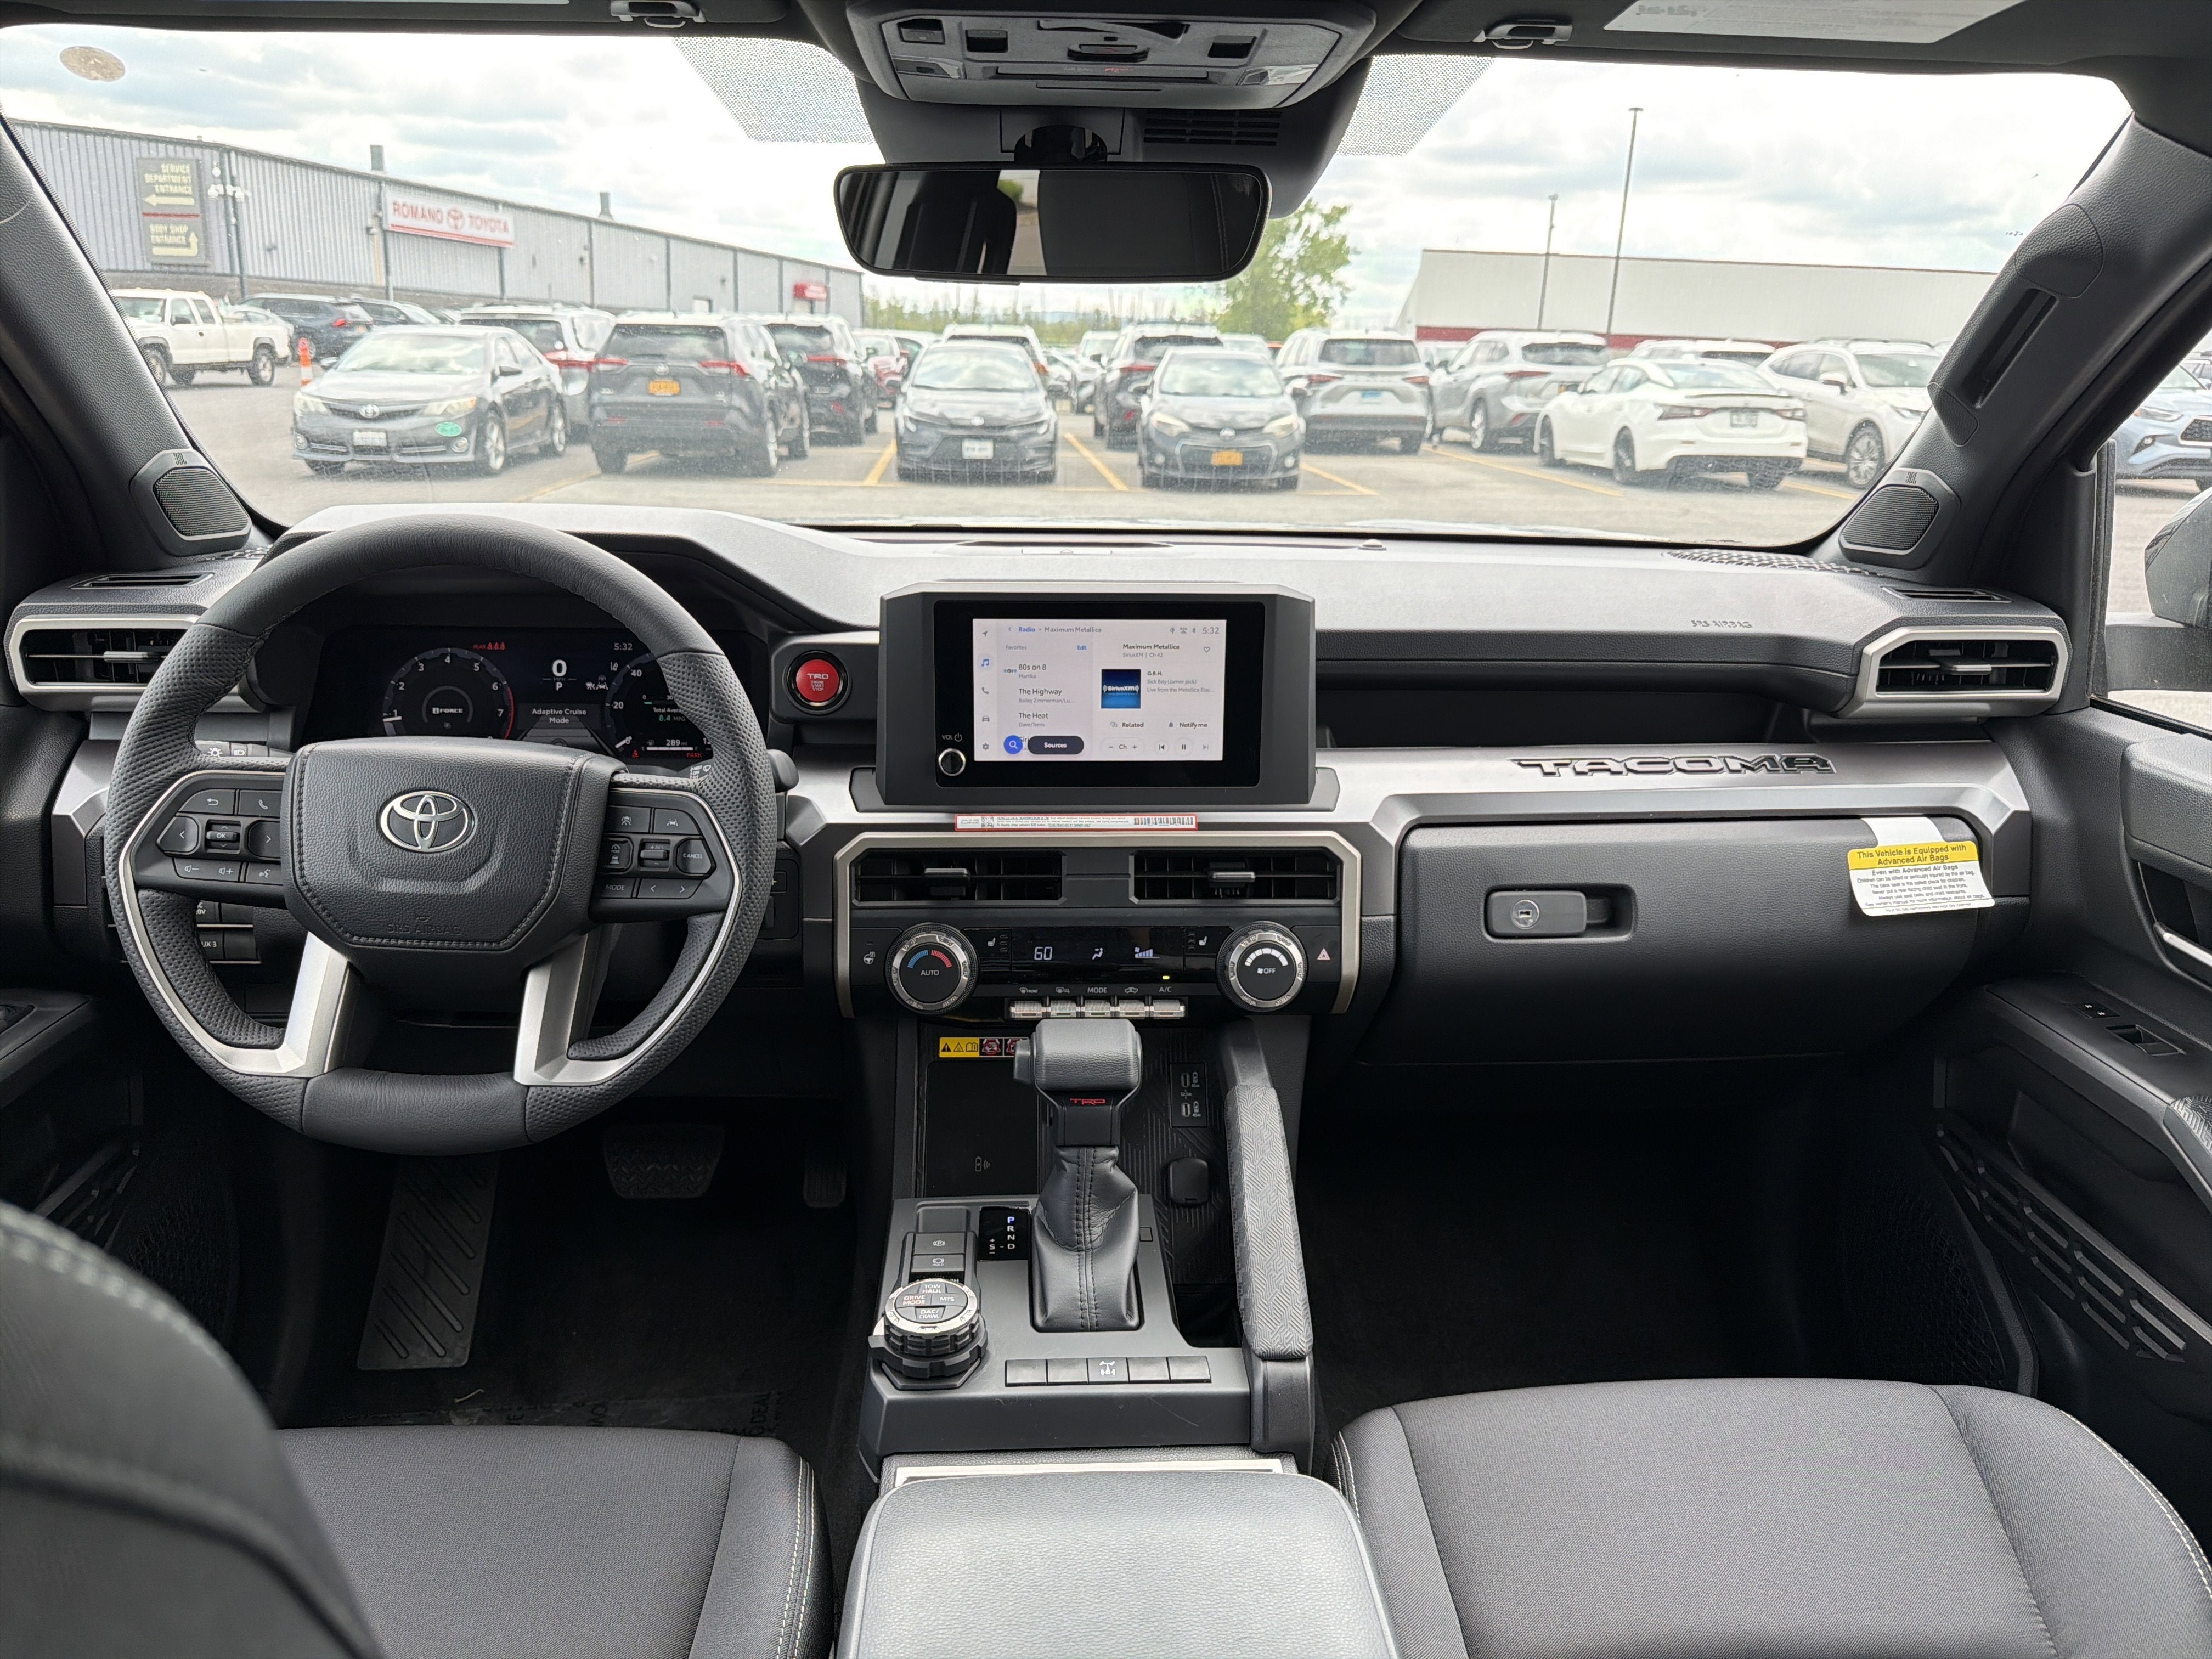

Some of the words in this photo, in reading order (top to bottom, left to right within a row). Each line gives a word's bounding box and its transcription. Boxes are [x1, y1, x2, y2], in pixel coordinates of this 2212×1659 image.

[392, 201, 443, 224] ROMANO
[468, 214, 509, 233] TOYOTA
[1905, 472, 1917, 484] JBL
[613, 642, 633, 651] 5:32
[444, 656, 450, 664] 4
[418, 663, 424, 672] 3
[473, 663, 480, 672] 5
[552, 659, 567, 677] 0
[631, 669, 642, 677] 40
[398, 682, 405, 690] 2
[492, 682, 498, 691] 6
[556, 682, 563, 691] P
[613, 701, 624, 709] 20
[497, 709, 504, 718] 7
[1506, 754, 1837, 777] TACOMA
[1875, 849, 1903, 857] Vehicle
[1914, 845, 1949, 855] Equipped
[1877, 856, 1915, 865] Advanced
[1034, 946, 1053, 960] 60
